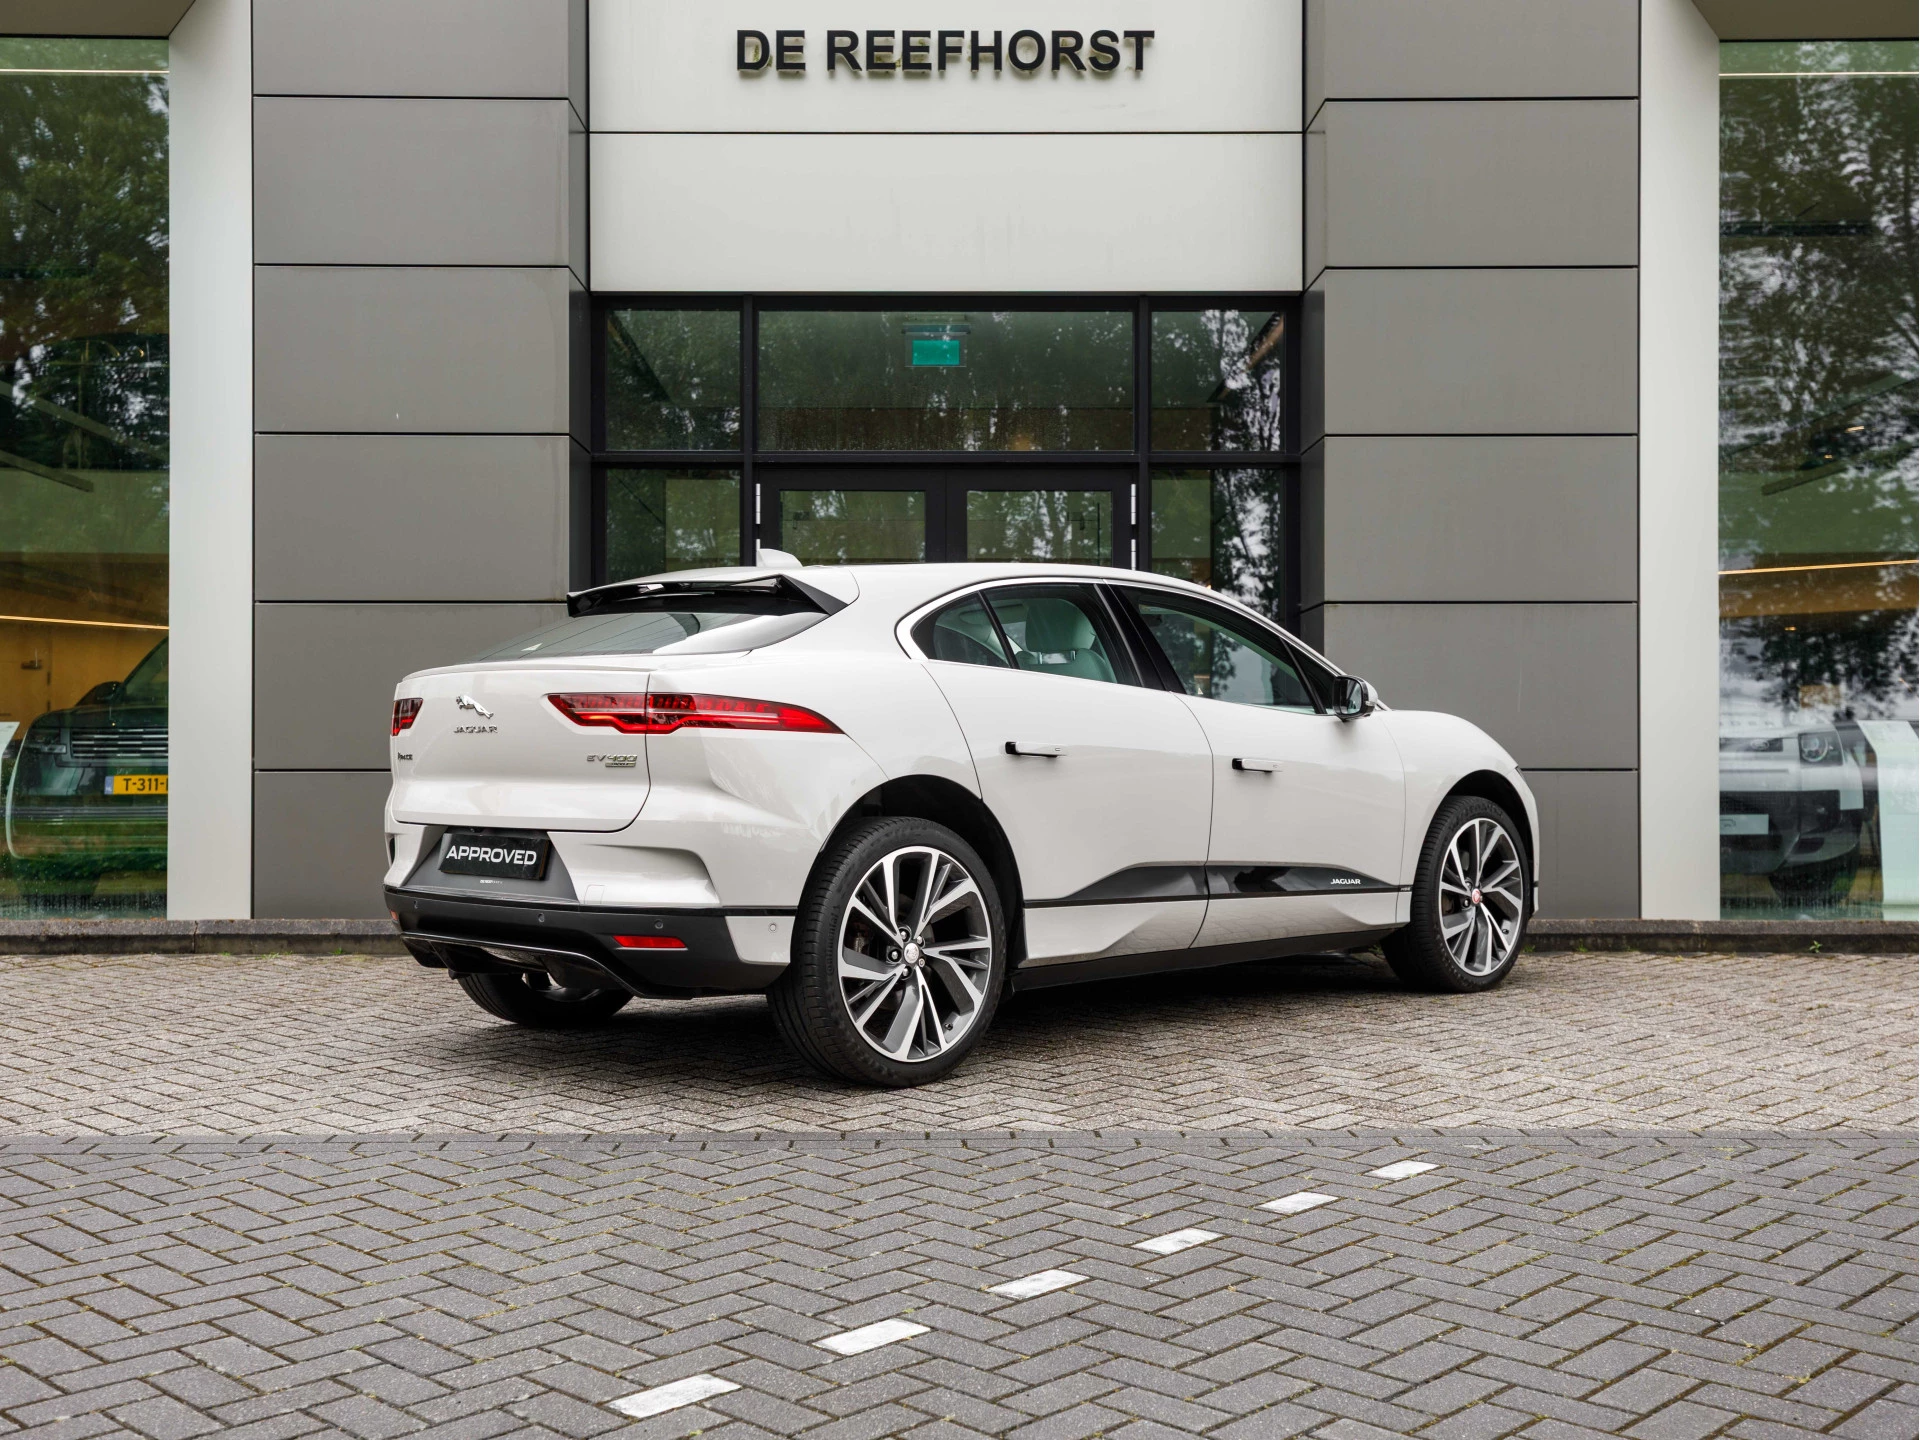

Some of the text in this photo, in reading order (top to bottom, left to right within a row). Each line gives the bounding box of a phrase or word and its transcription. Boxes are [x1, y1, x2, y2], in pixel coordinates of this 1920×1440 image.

[737, 30, 1155, 73] DE REEFHORST
[453, 726, 498, 734] JAGUAR
[123, 777, 168, 792] T-311-
[446, 845, 537, 865] APPROVED
